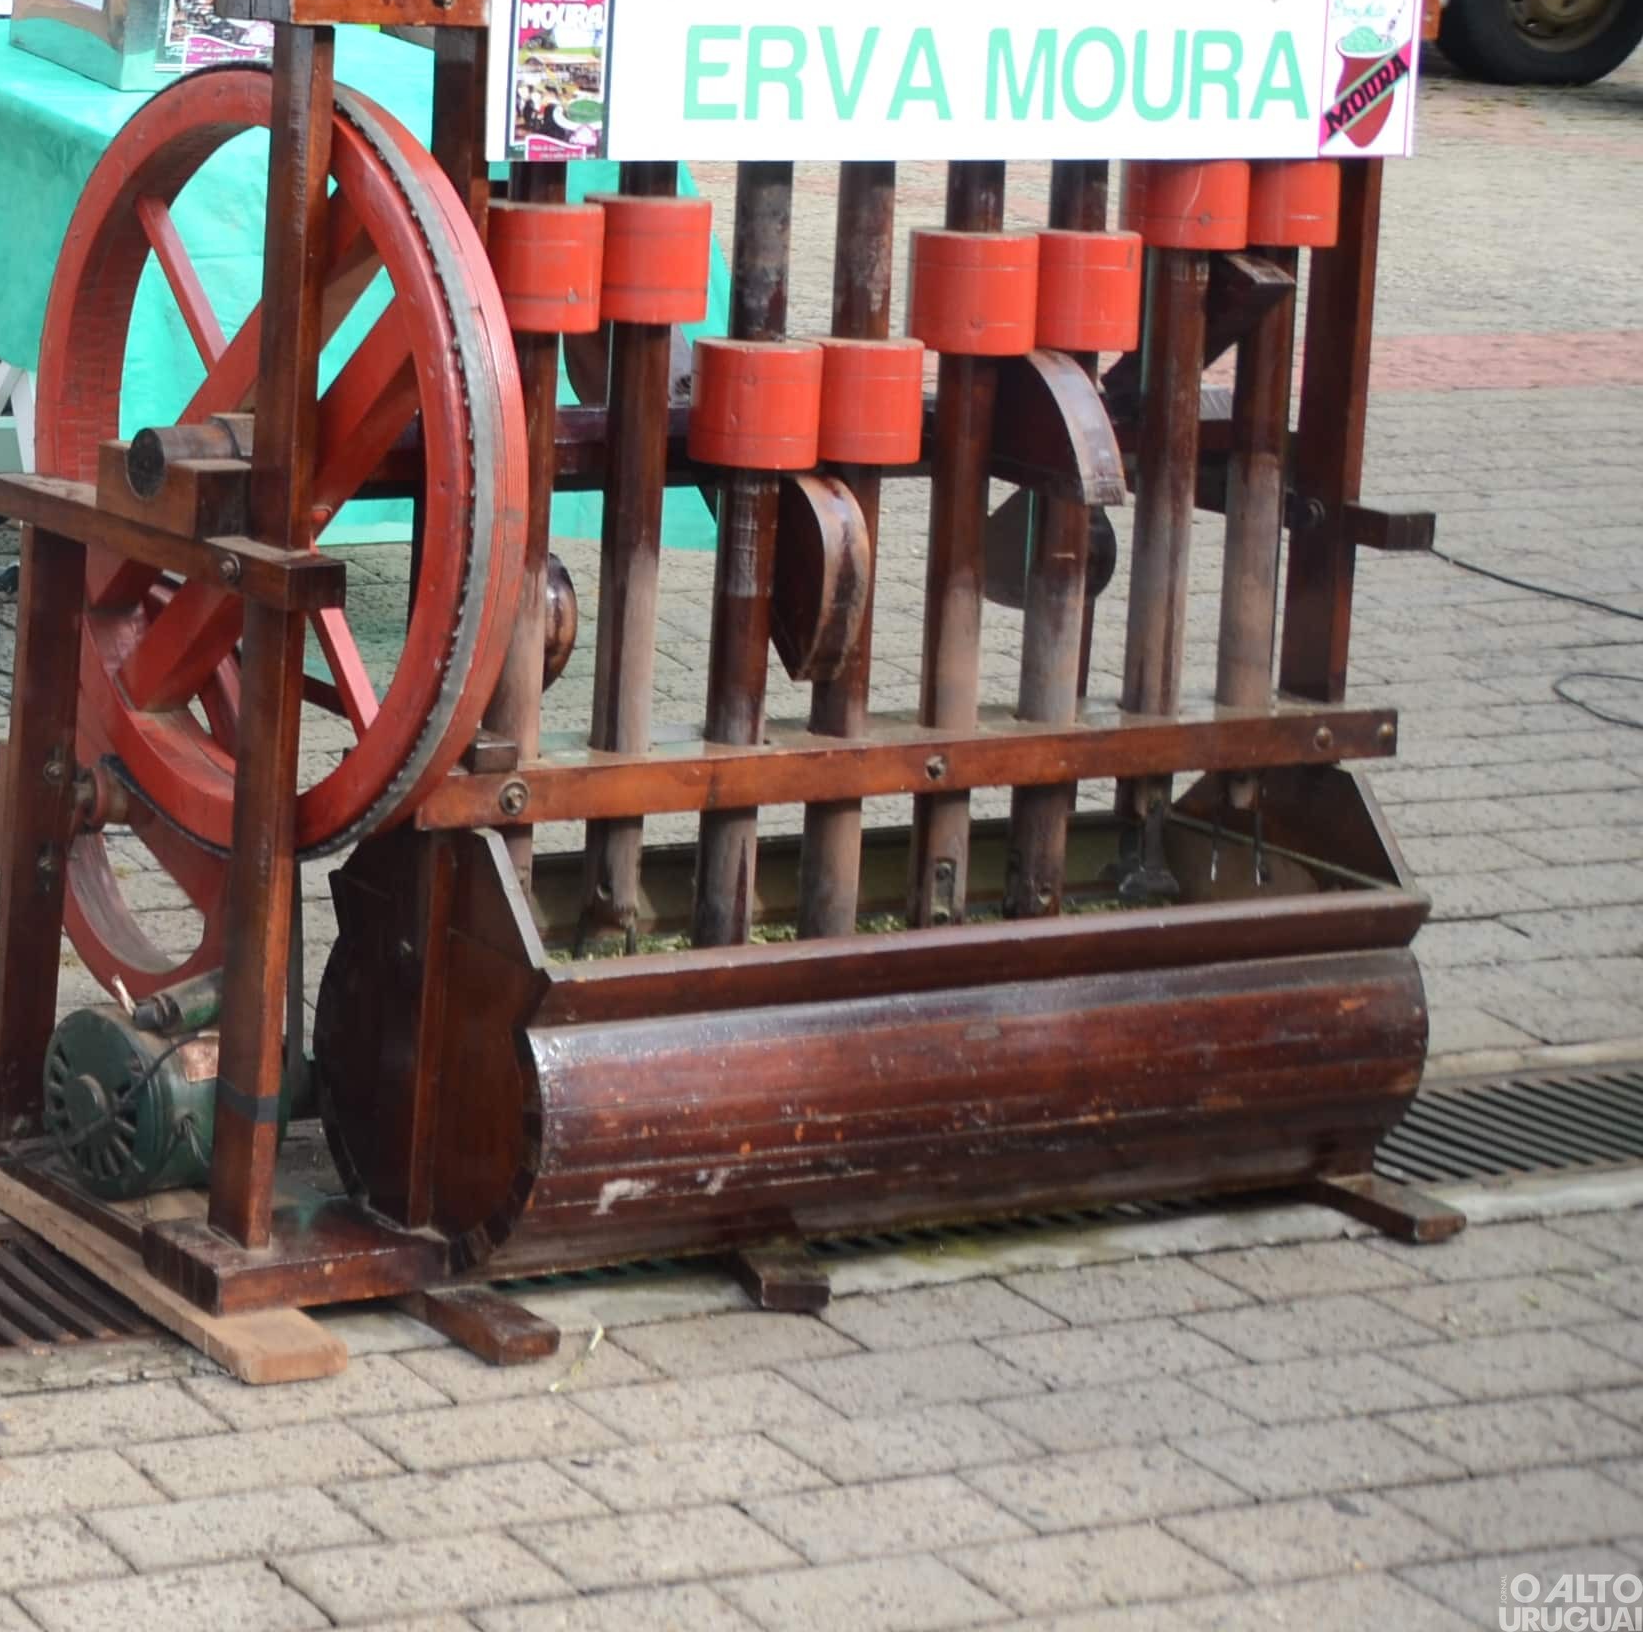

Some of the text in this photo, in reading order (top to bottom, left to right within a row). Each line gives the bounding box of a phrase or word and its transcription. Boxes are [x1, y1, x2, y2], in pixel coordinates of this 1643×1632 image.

[520, 1, 604, 30] MOURA
[681, 24, 1310, 123] ERVA MOURA
[1324, 54, 1409, 140] MOURA
